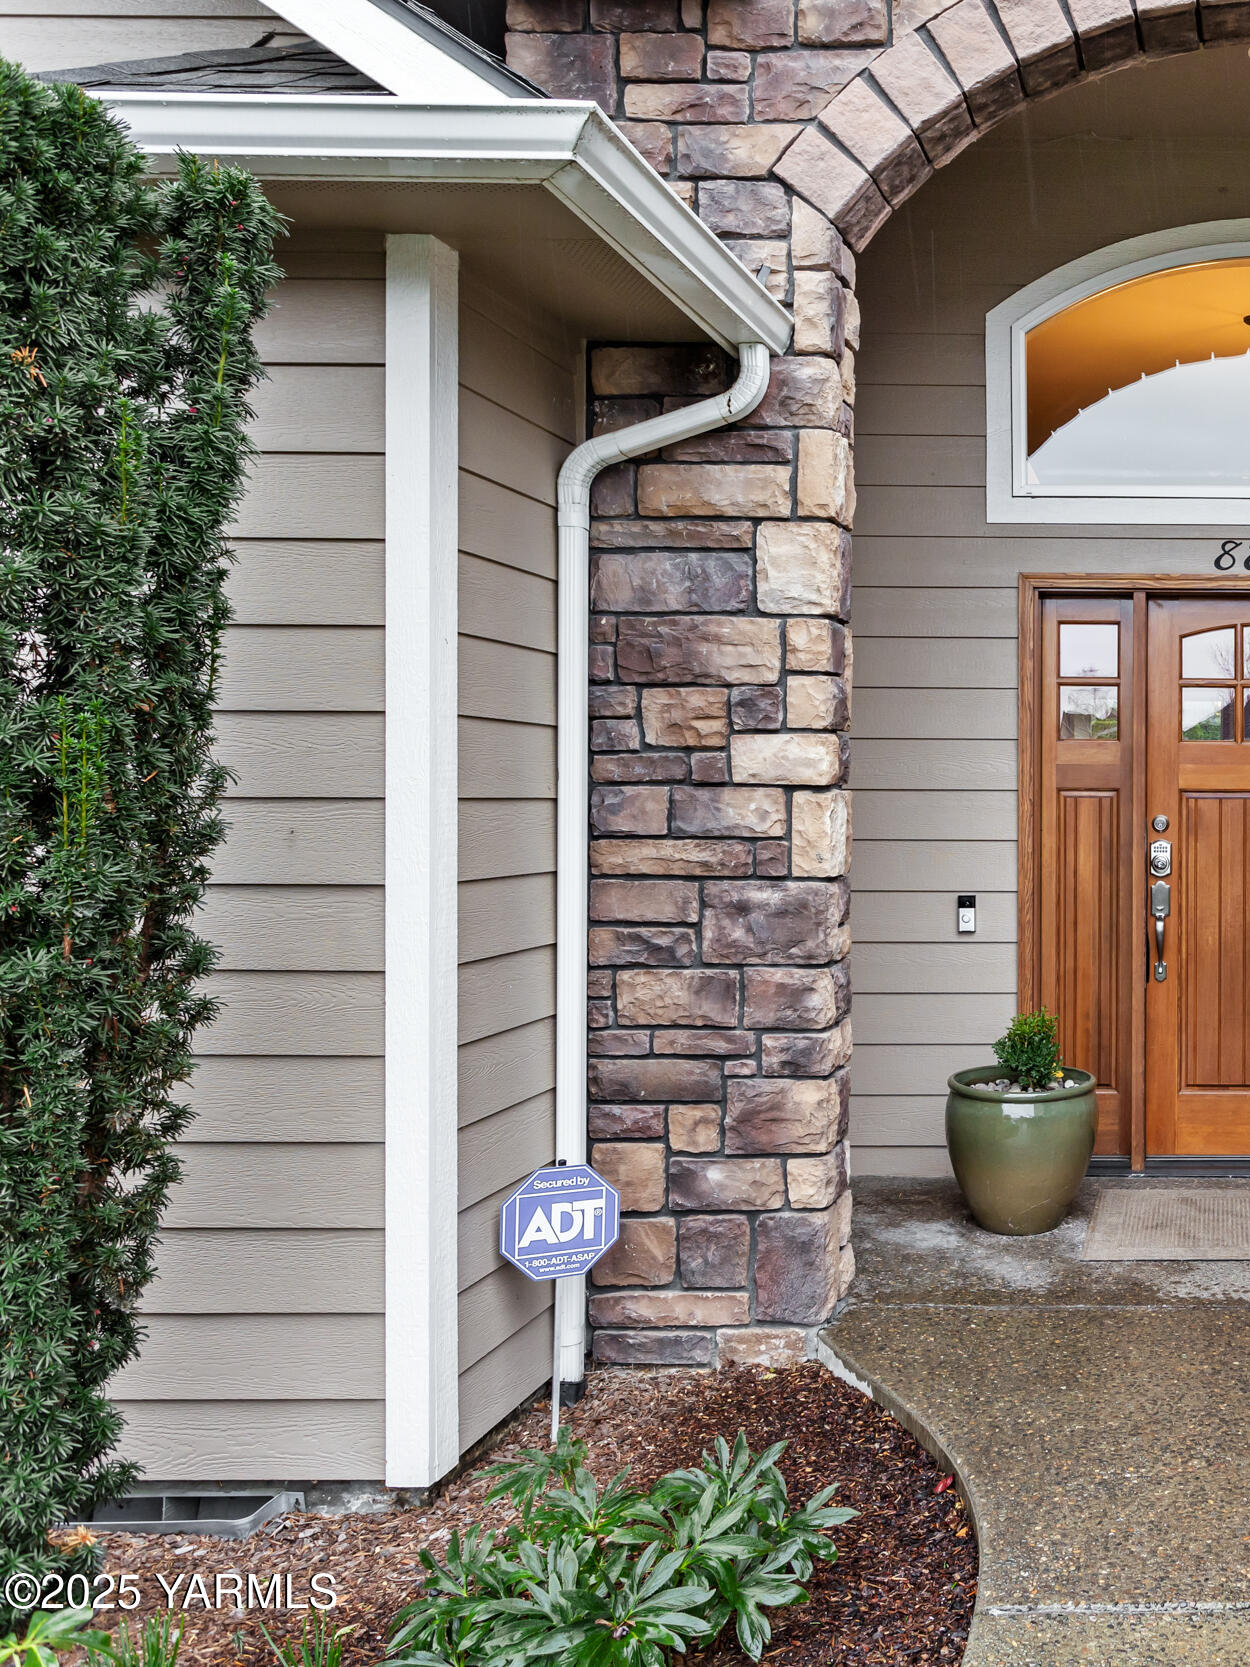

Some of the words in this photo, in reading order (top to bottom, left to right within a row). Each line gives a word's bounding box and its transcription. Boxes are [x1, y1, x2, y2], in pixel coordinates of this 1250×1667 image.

[533, 1176, 577, 1190] Secured
[577, 1176, 590, 1186] by
[524, 1252, 595, 1268] 1-800-ADT-ASAP
[539, 1263, 580, 1273] www.adt.com
